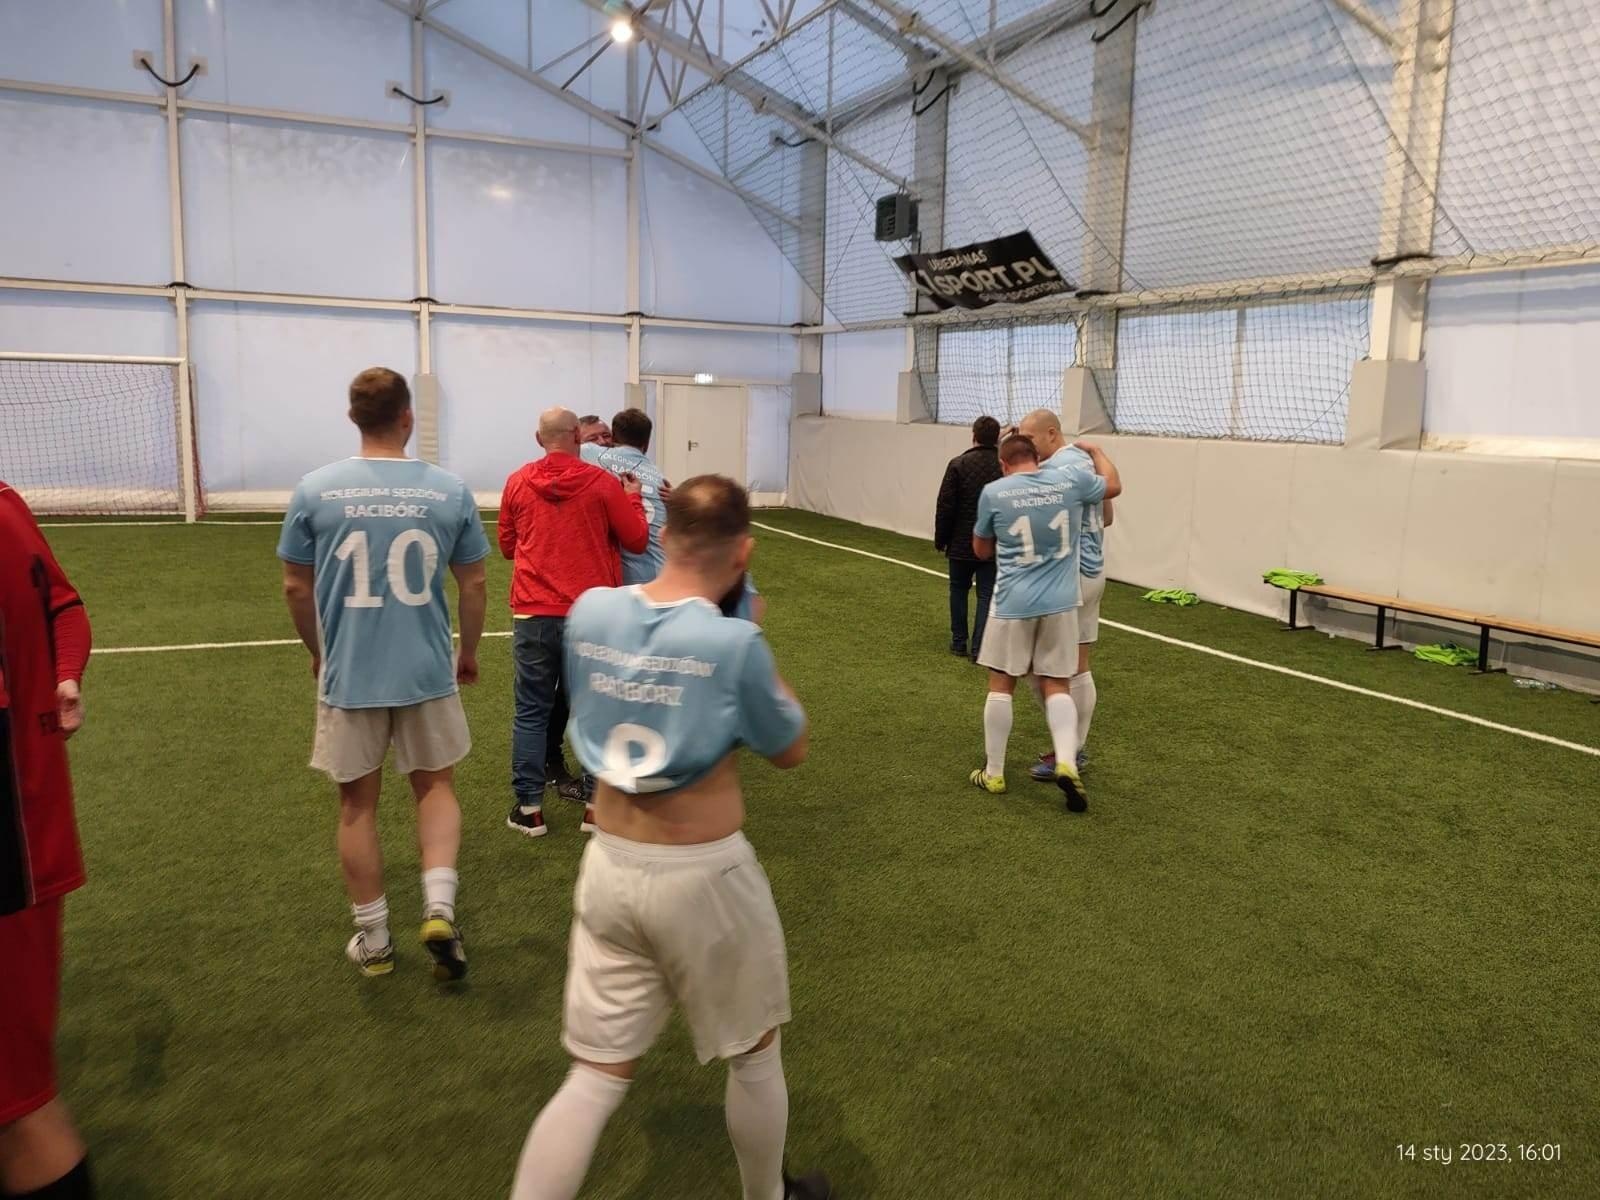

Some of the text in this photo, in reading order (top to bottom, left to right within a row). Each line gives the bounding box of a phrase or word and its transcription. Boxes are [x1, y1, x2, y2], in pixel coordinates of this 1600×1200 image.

[344, 501, 430, 518] RACIBÓRZ
[1007, 509, 1072, 565] 11
[333, 528, 439, 608] 10
